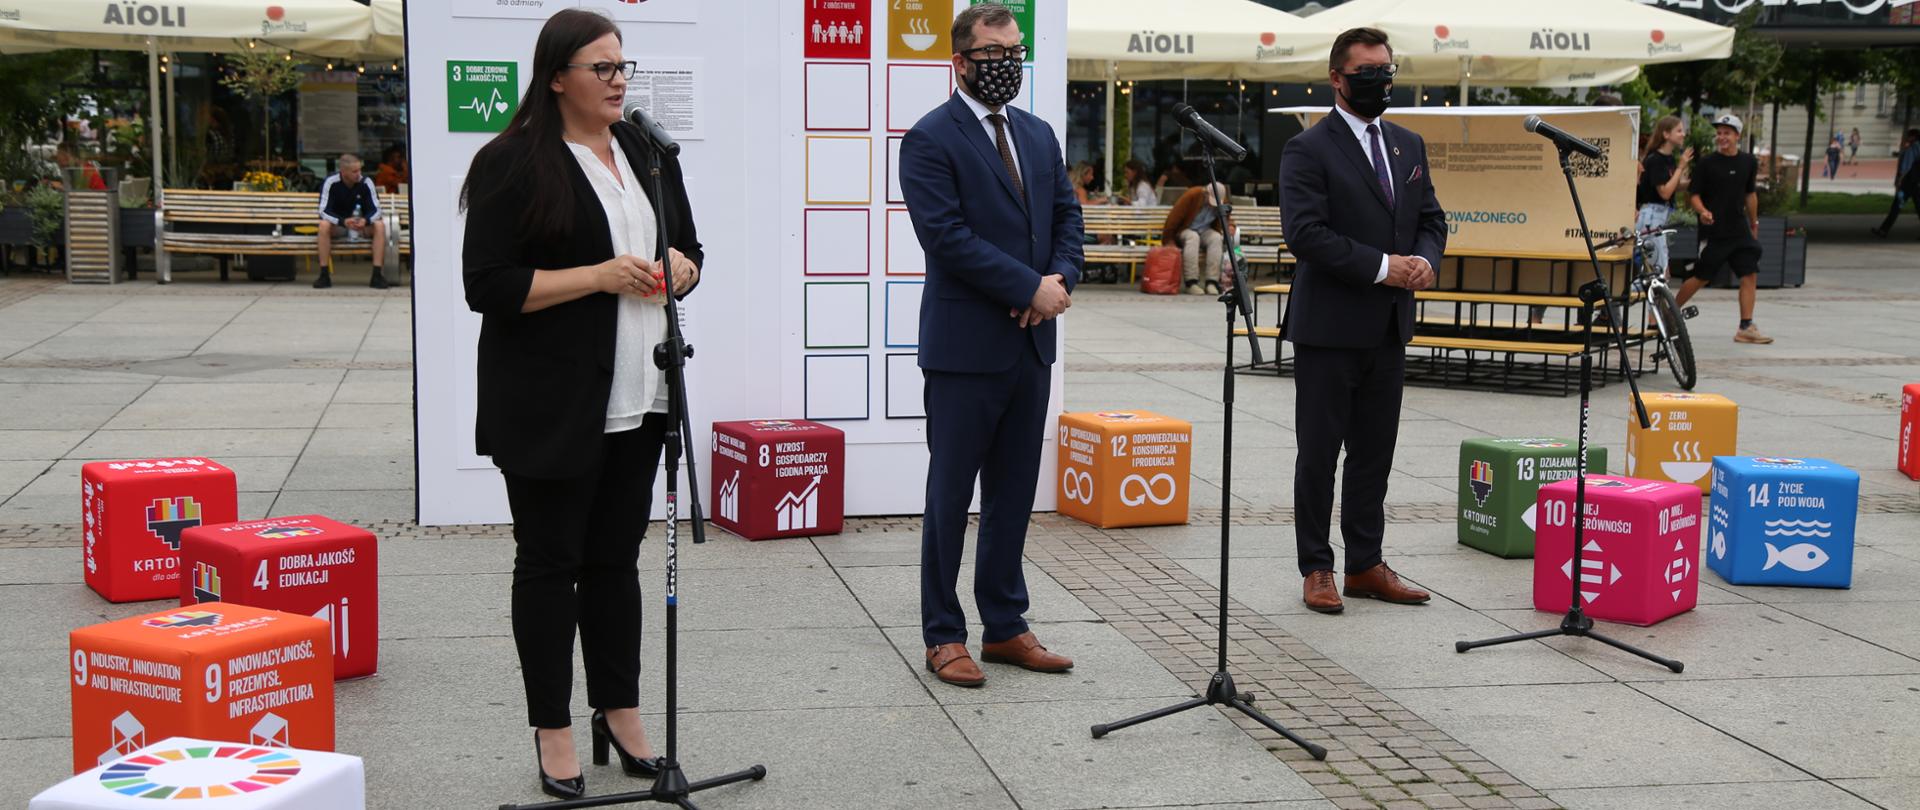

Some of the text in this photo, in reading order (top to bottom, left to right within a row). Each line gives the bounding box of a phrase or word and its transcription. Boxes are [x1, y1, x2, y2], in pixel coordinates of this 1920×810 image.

[510, 0, 543, 8] odmiany
[453, 65, 462, 81] 3
[1444, 210, 1527, 224] OWAŻONEGO
[1565, 229, 1618, 239] #17ktowice
[1650, 411, 1687, 431] 2 ZERO
[1668, 422, 1692, 431] GŁODU
[713, 431, 718, 452] 8
[1060, 425, 1069, 447] 12
[1111, 433, 1188, 457] 12 ODPOWIEDZIALNA
[759, 442, 805, 467] 8 WZROST
[776, 453, 828, 465] GOSPODARCZY
[1132, 445, 1176, 455] KONSUMPCJA
[776, 465, 828, 478] I GODNA PRACA
[1135, 456, 1175, 467] PRODUKCJA
[1517, 457, 1577, 481] 13 DZIAŁANIA
[1539, 469, 1578, 480] W DZIEDZIN
[1748, 483, 1770, 508] 14
[1778, 481, 1804, 494] ŻYCIE
[1778, 497, 1825, 509] POD WODĄ
[1463, 508, 1497, 528] KATOWICE
[1544, 499, 1566, 527] 10
[1658, 508, 1669, 536] 10
[133, 557, 180, 572] KATO
[253, 548, 355, 590] 4 DOBRA JAKOŚĆ
[279, 570, 329, 588] EDUKACJI
[73, 649, 181, 686] 9 INDUSTRY, INNOVATION
[205, 640, 315, 703] 9 INNOWACYJNOŚĆ,
[91, 674, 182, 704] AND INFRASTRUCTURE
[229, 669, 282, 698] PRZEMYSŁ,
[229, 683, 314, 720] INFRASTRUKTURA
